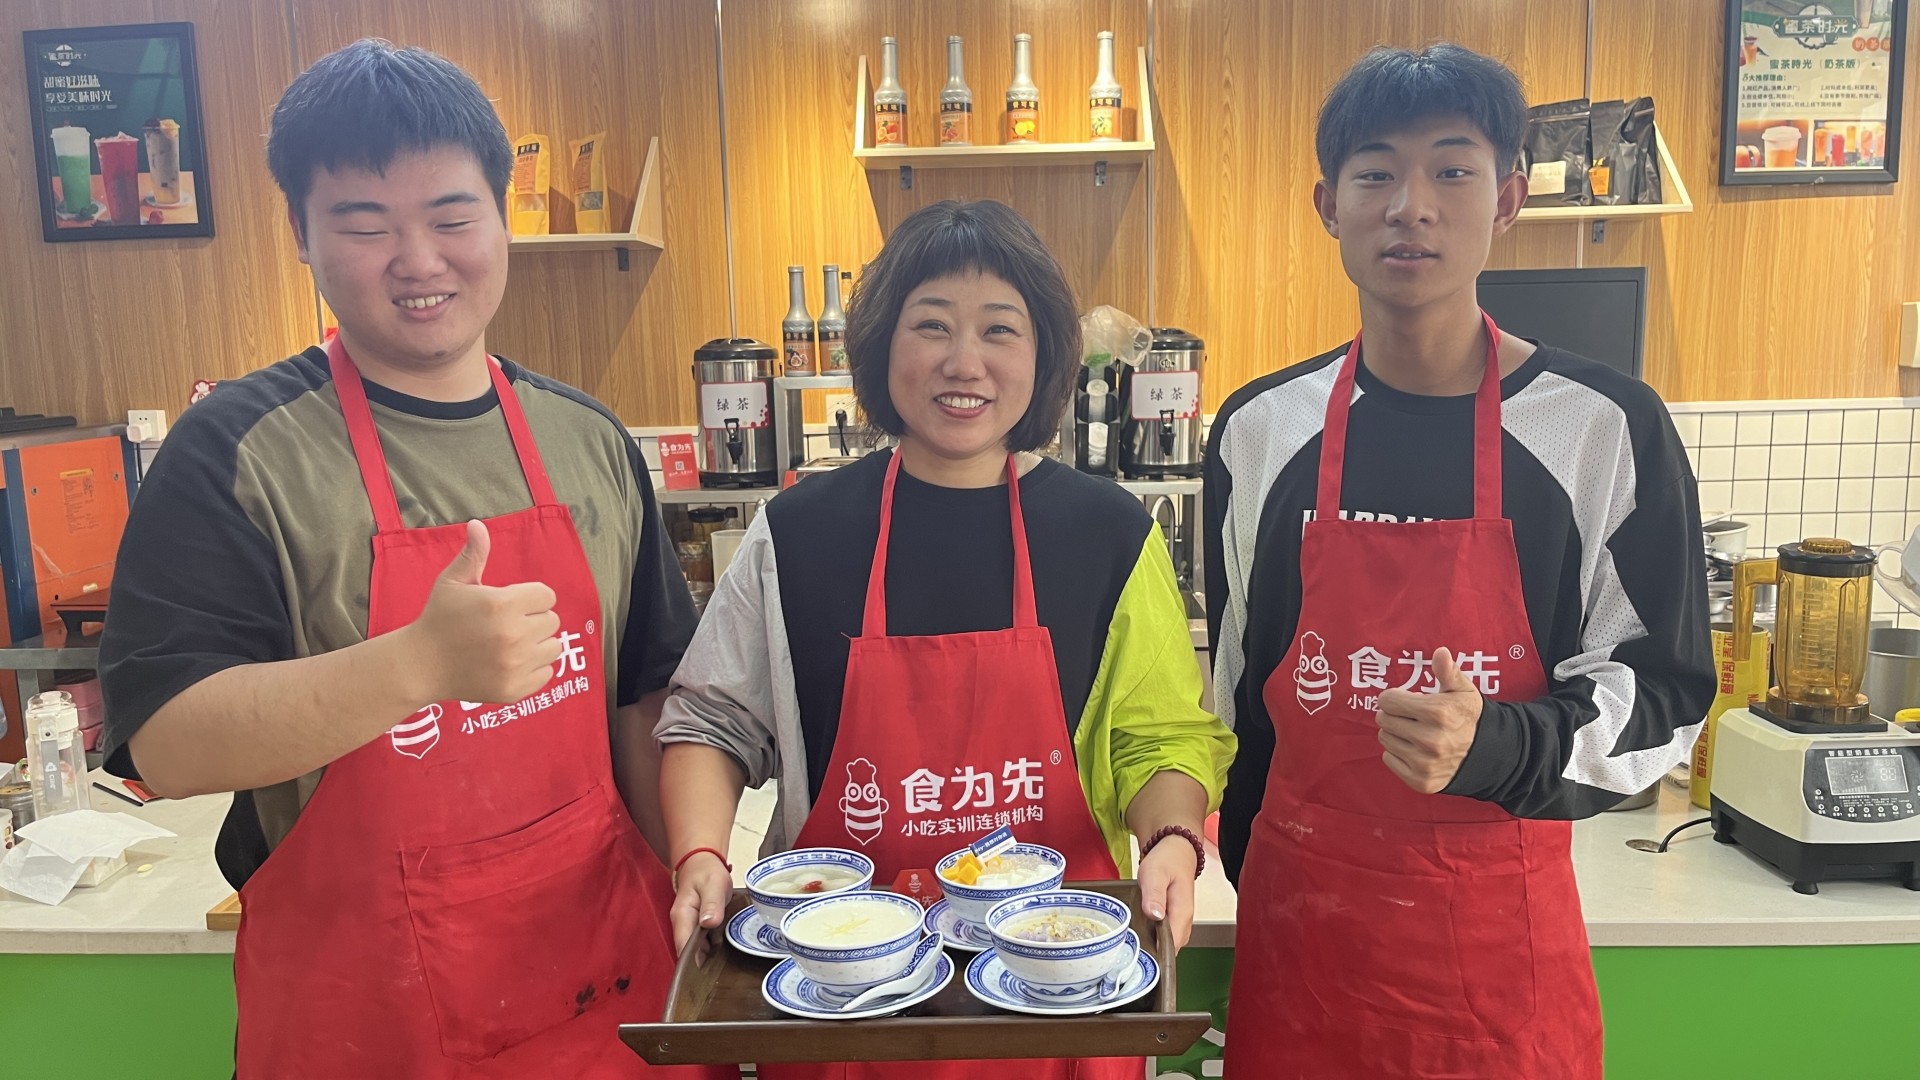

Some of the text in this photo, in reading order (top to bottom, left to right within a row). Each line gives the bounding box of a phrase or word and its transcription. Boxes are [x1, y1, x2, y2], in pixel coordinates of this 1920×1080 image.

[1783, 18, 1848, 33] 蜜茶时光
[45, 90, 112, 103] 享受美味时光
[461, 676, 589, 733] 小吃实训连锁机构
[900, 757, 1044, 814] 食为先
[900, 805, 1044, 836] 小吃实训连锁机构
